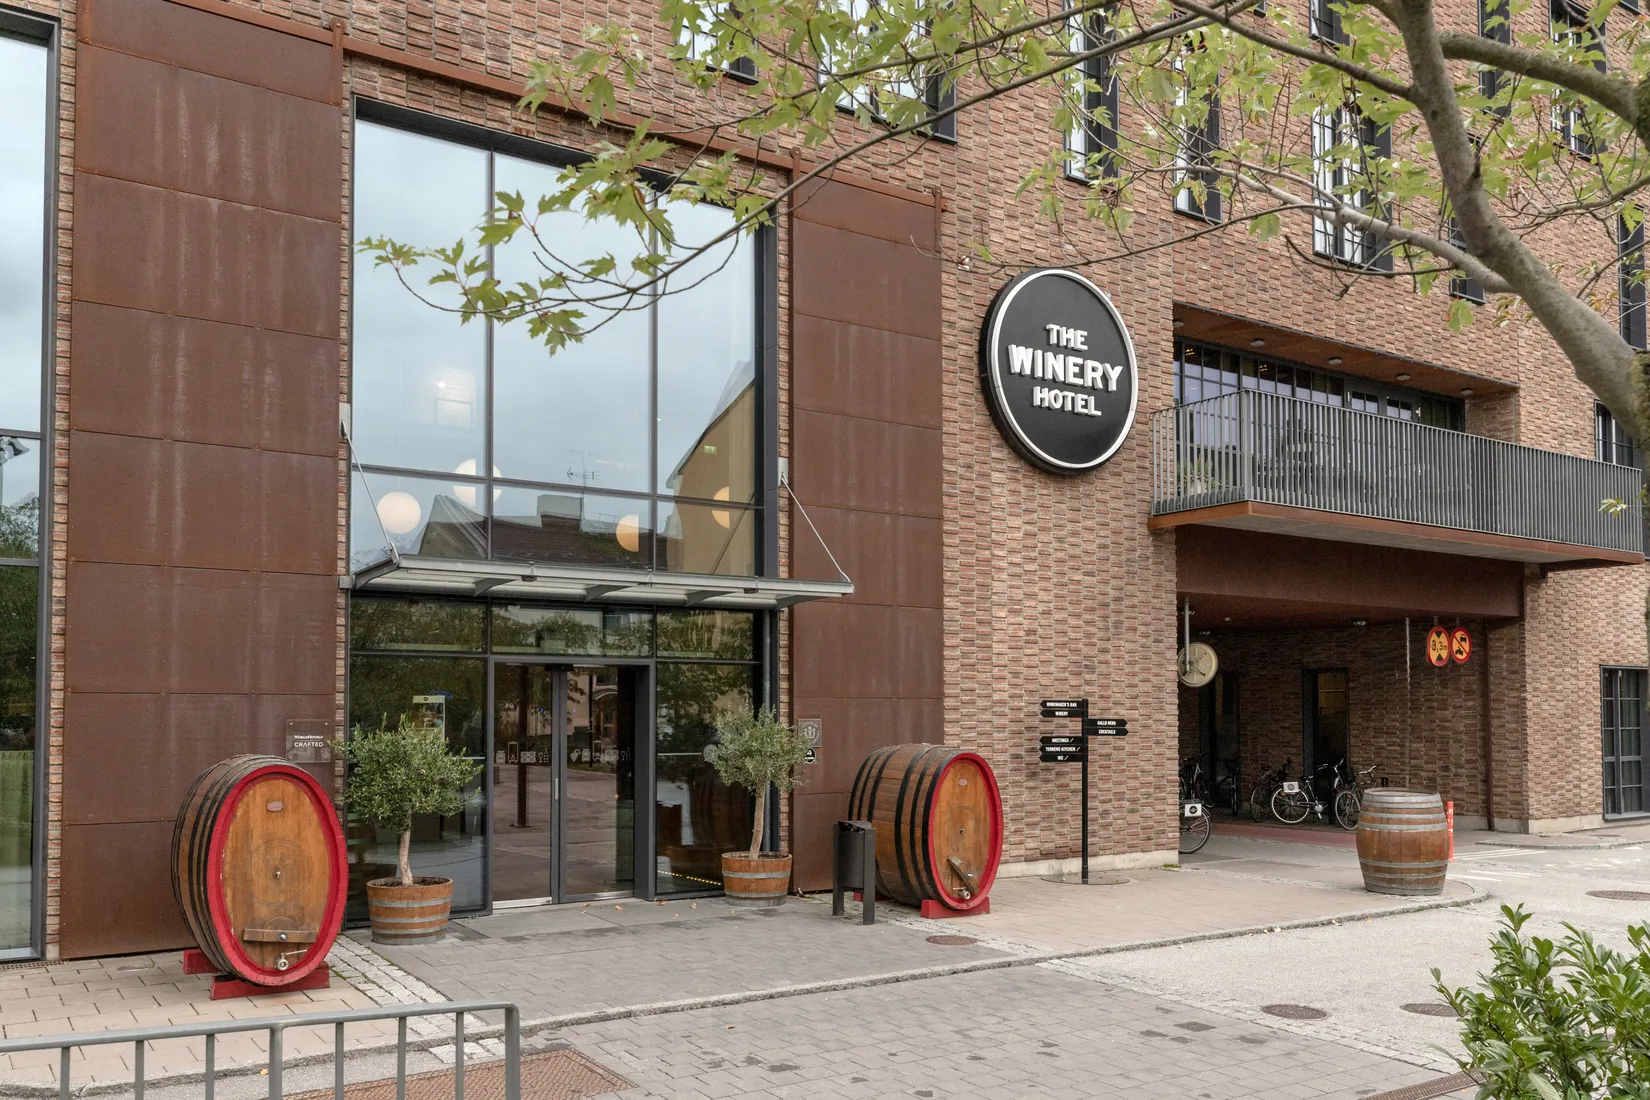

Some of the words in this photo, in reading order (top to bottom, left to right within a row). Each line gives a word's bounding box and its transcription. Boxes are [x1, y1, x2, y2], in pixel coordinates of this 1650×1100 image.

[1046, 324, 1088, 350] THE
[1008, 344, 1123, 391] WINERY
[1033, 386, 1101, 416] HOTEL
